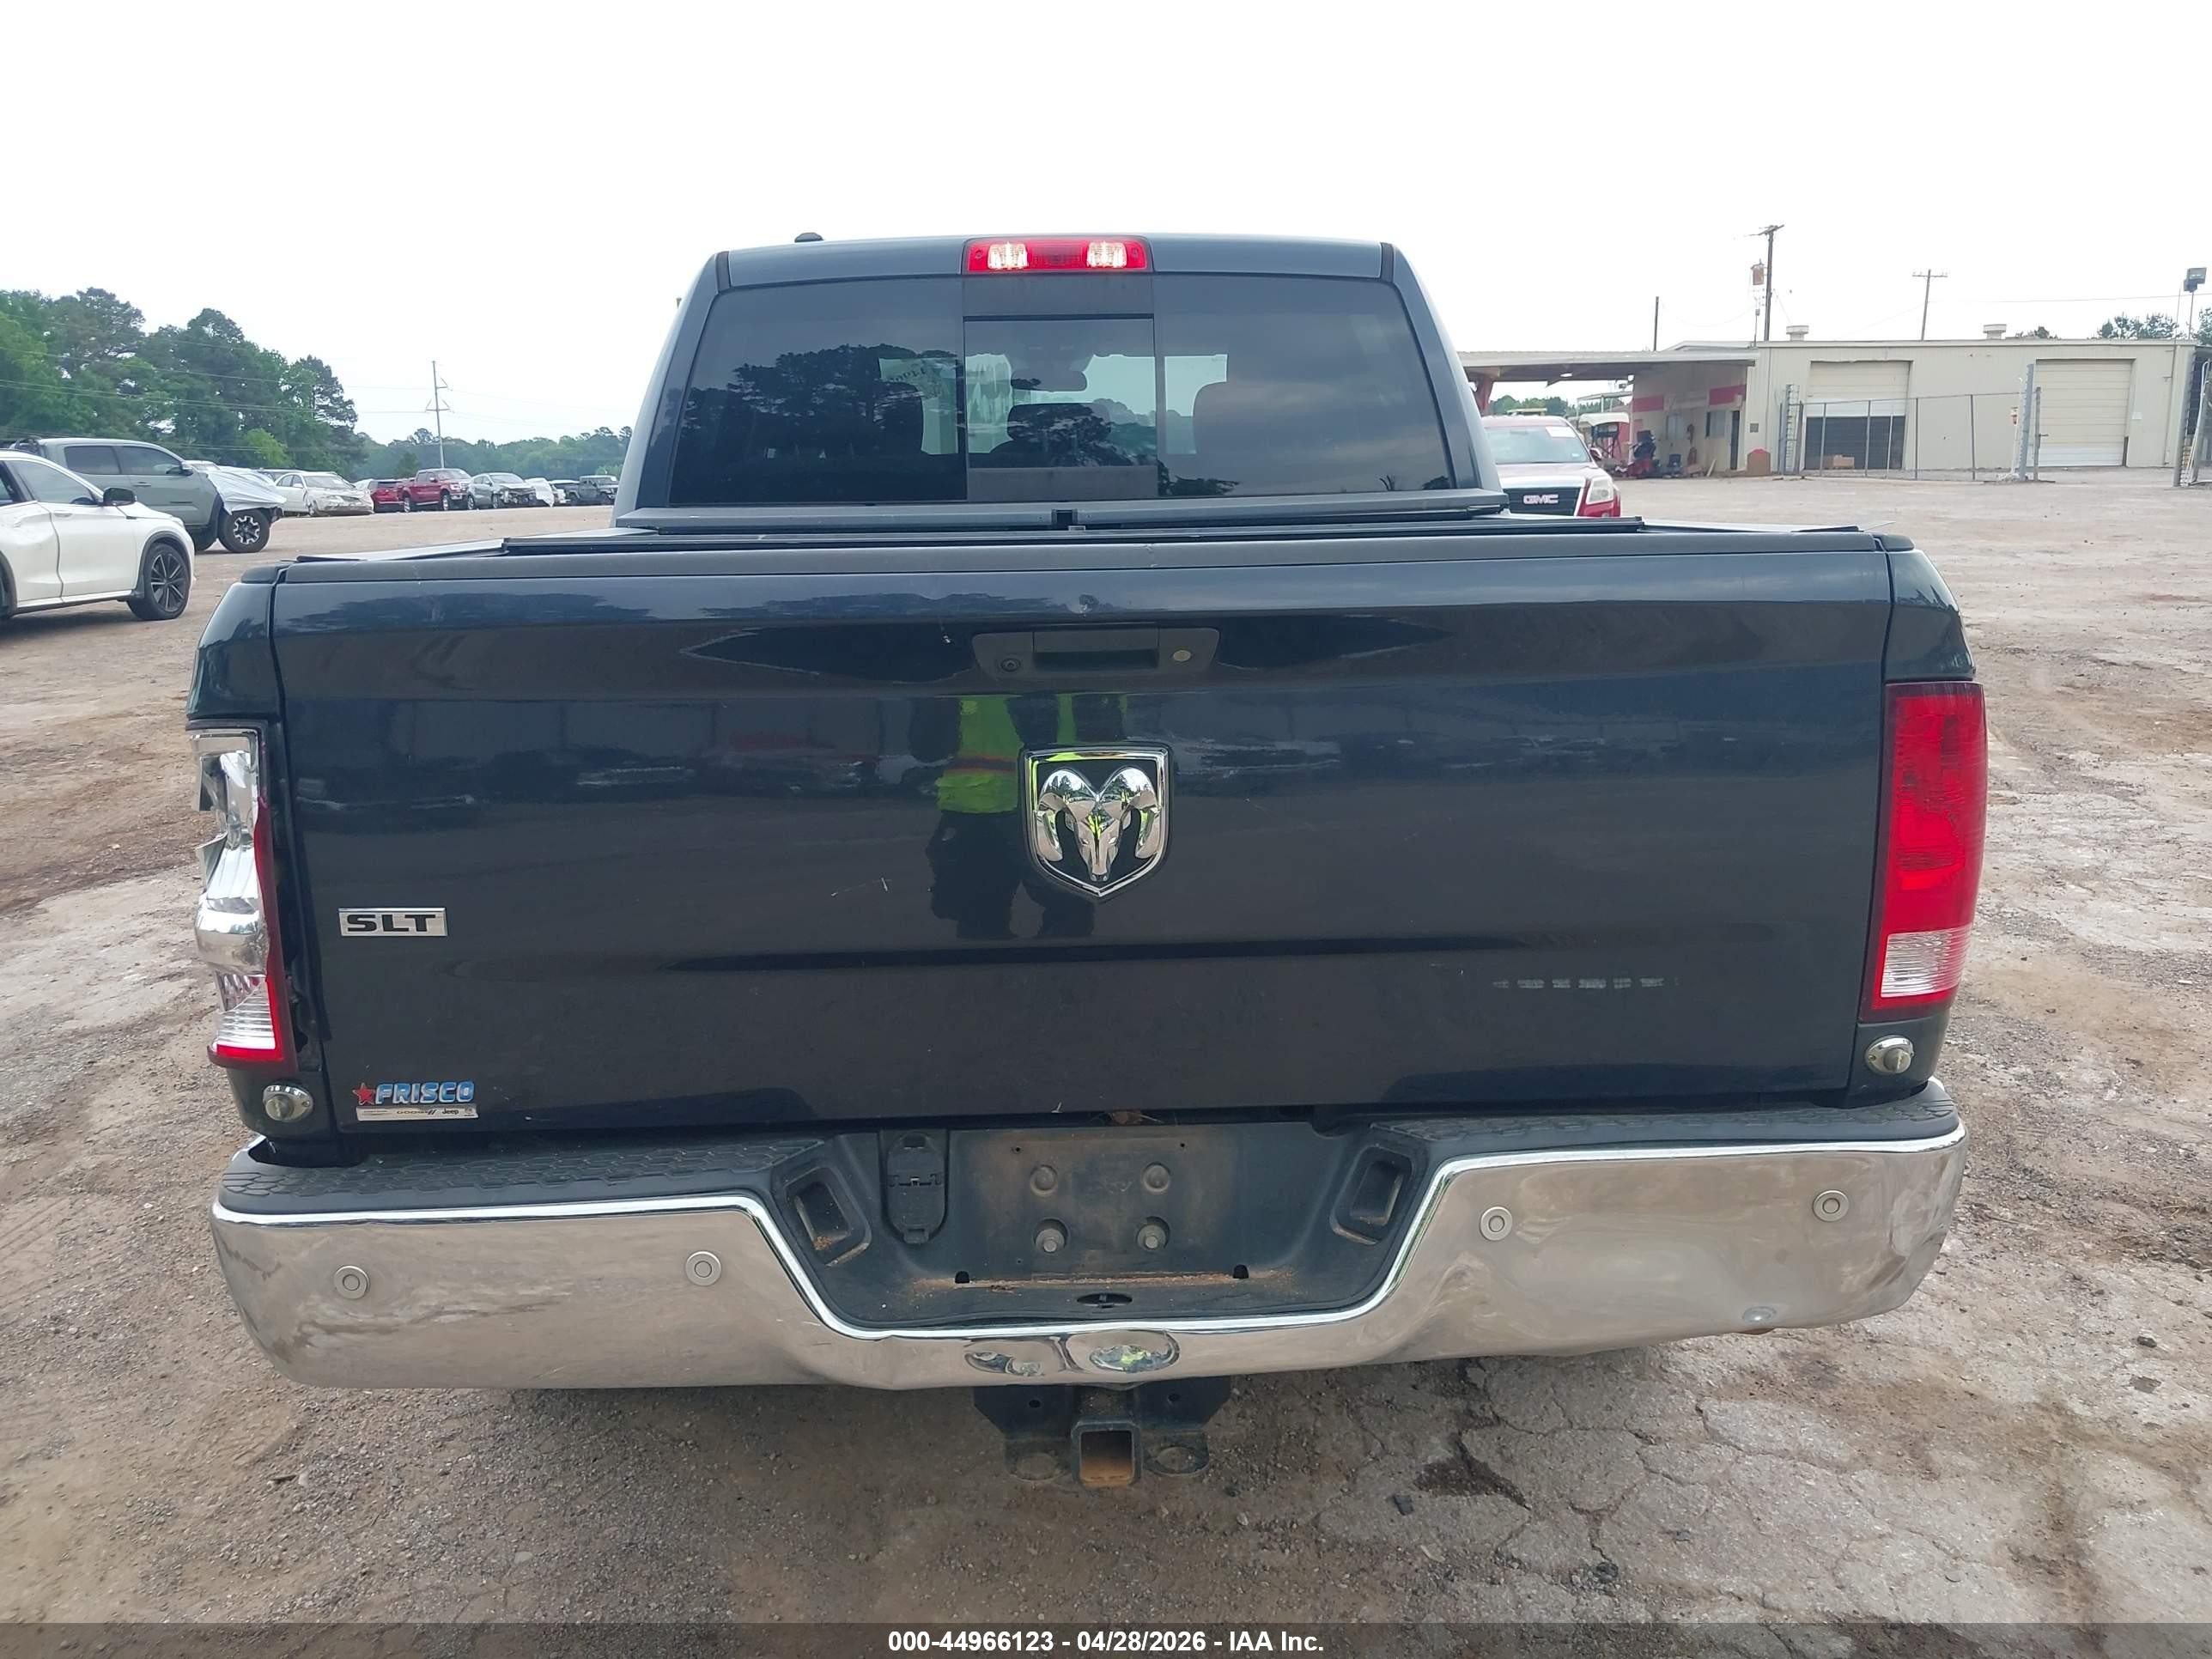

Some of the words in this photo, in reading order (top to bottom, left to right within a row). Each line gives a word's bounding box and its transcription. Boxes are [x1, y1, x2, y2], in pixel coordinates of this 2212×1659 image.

[1523, 494, 1559, 505] GMC
[346, 914, 436, 932] SLT
[375, 1080, 475, 1104] FRISCO
